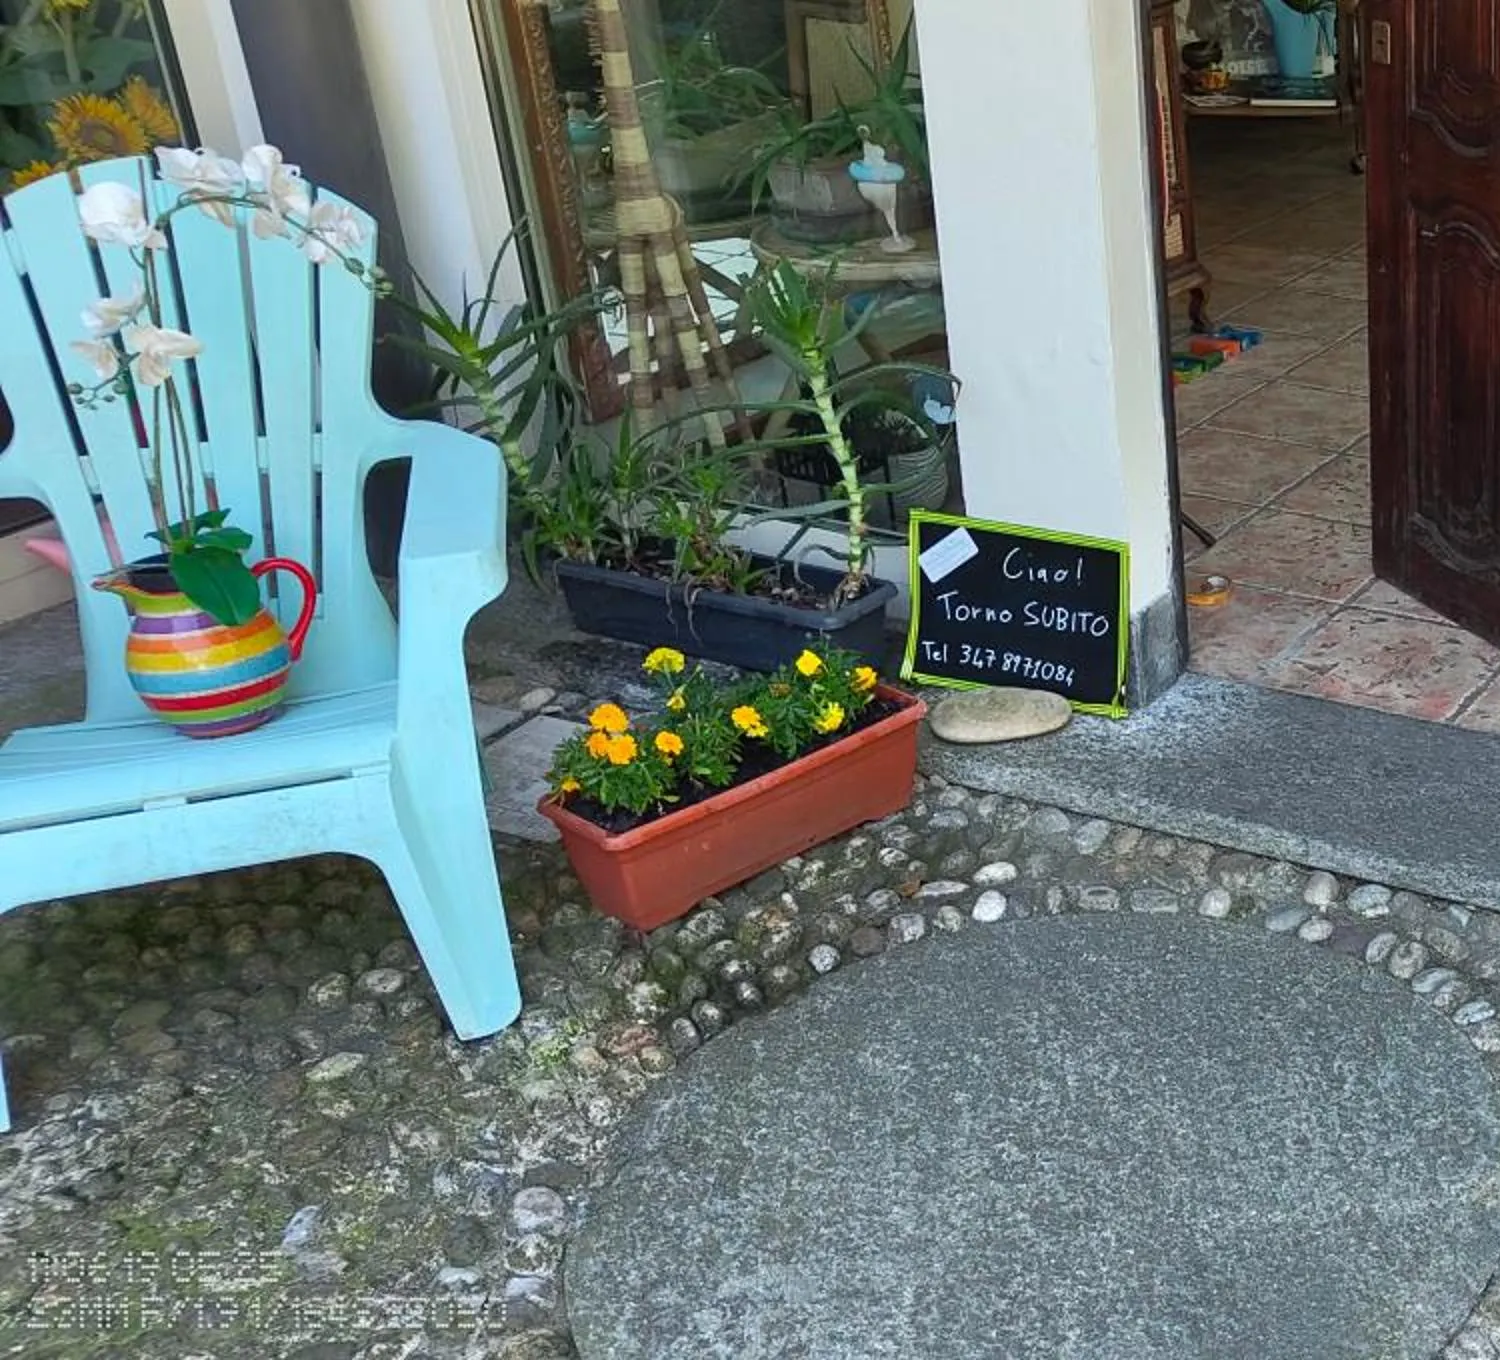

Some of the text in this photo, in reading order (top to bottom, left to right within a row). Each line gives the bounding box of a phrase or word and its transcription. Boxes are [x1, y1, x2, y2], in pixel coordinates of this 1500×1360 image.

[1003, 547, 1084, 586] Ciao!
[937, 590, 1109, 637] Torno SUBITO
[922, 640, 1075, 687] Tel 347 8971084
